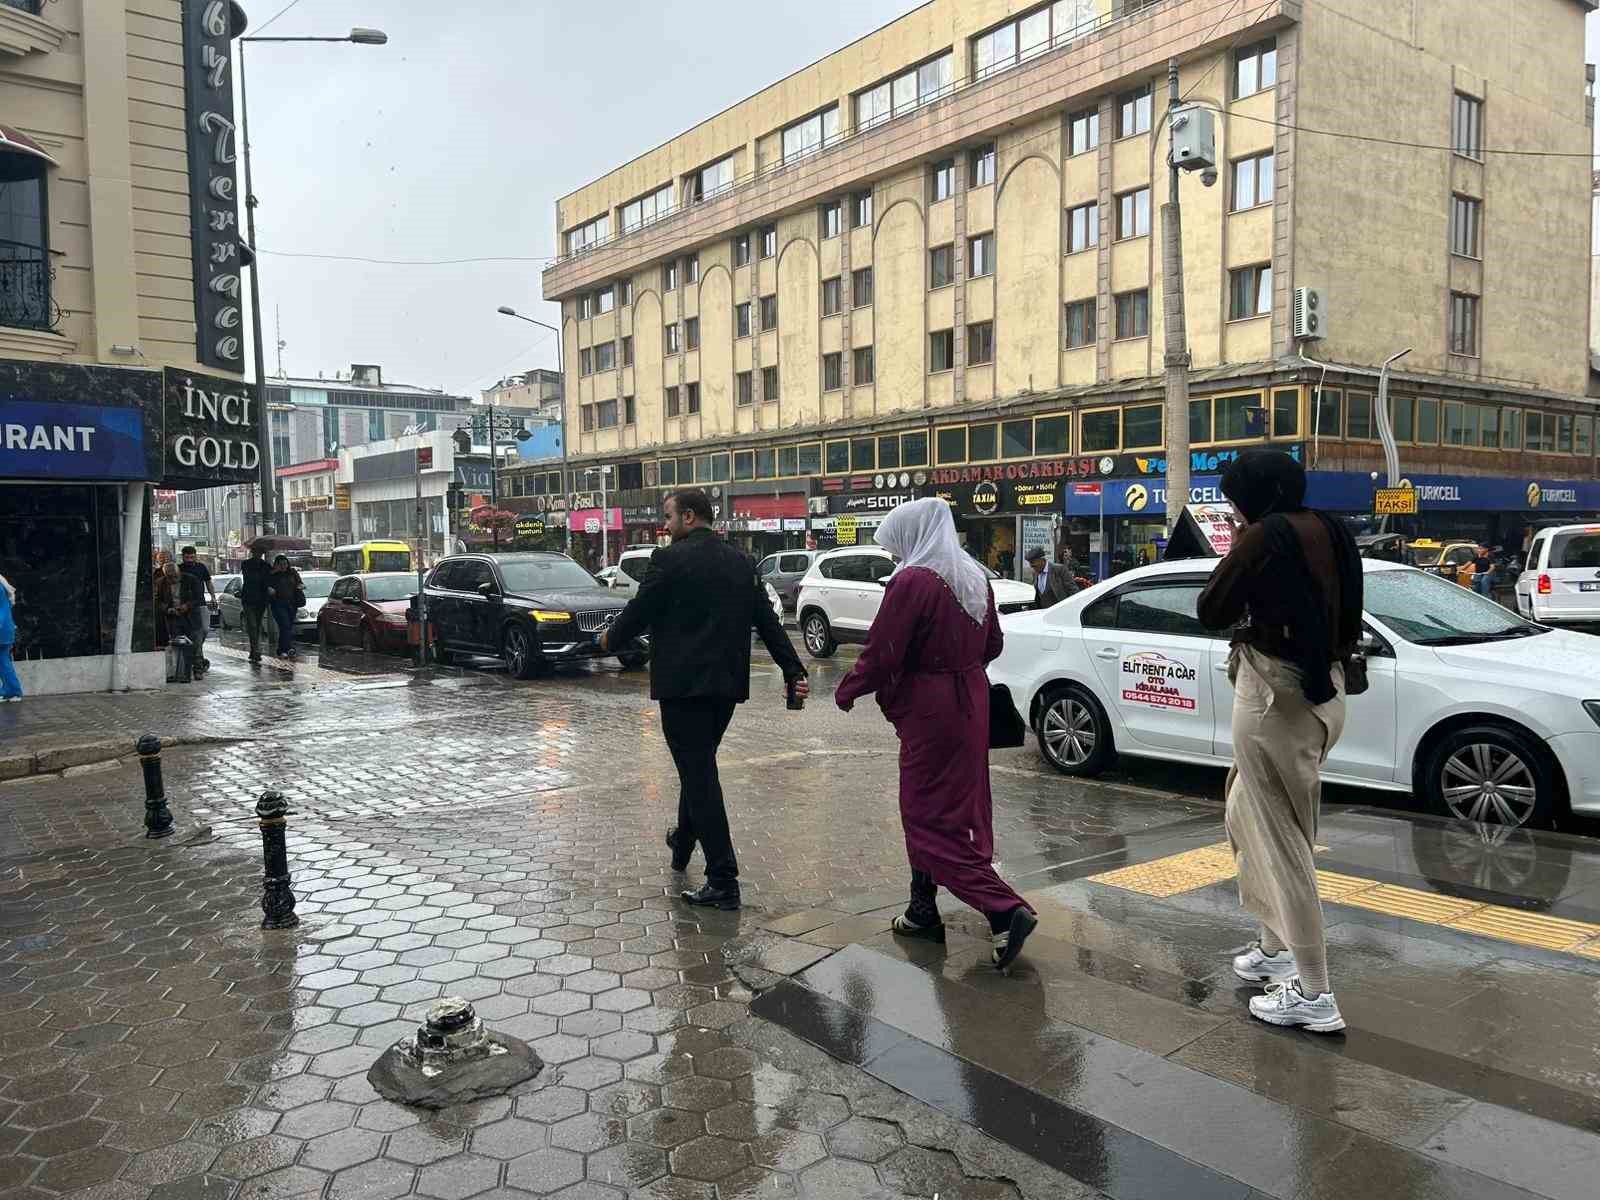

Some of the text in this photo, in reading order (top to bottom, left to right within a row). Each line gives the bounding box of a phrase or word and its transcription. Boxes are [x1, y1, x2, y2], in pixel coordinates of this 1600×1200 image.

[184, 378, 251, 426] İNCİ
[0, 423, 96, 451] RANT
[175, 435, 259, 470] GOLD
[1415, 485, 1461, 501] TURKCELL
[1541, 488, 1577, 502] TURKCELL
[1122, 659, 1196, 680] ELİT RENT A CAR
[1147, 676, 1165, 685] OTO
[1125, 691, 1149, 702] 0544
[1167, 696, 1180, 706] 20
